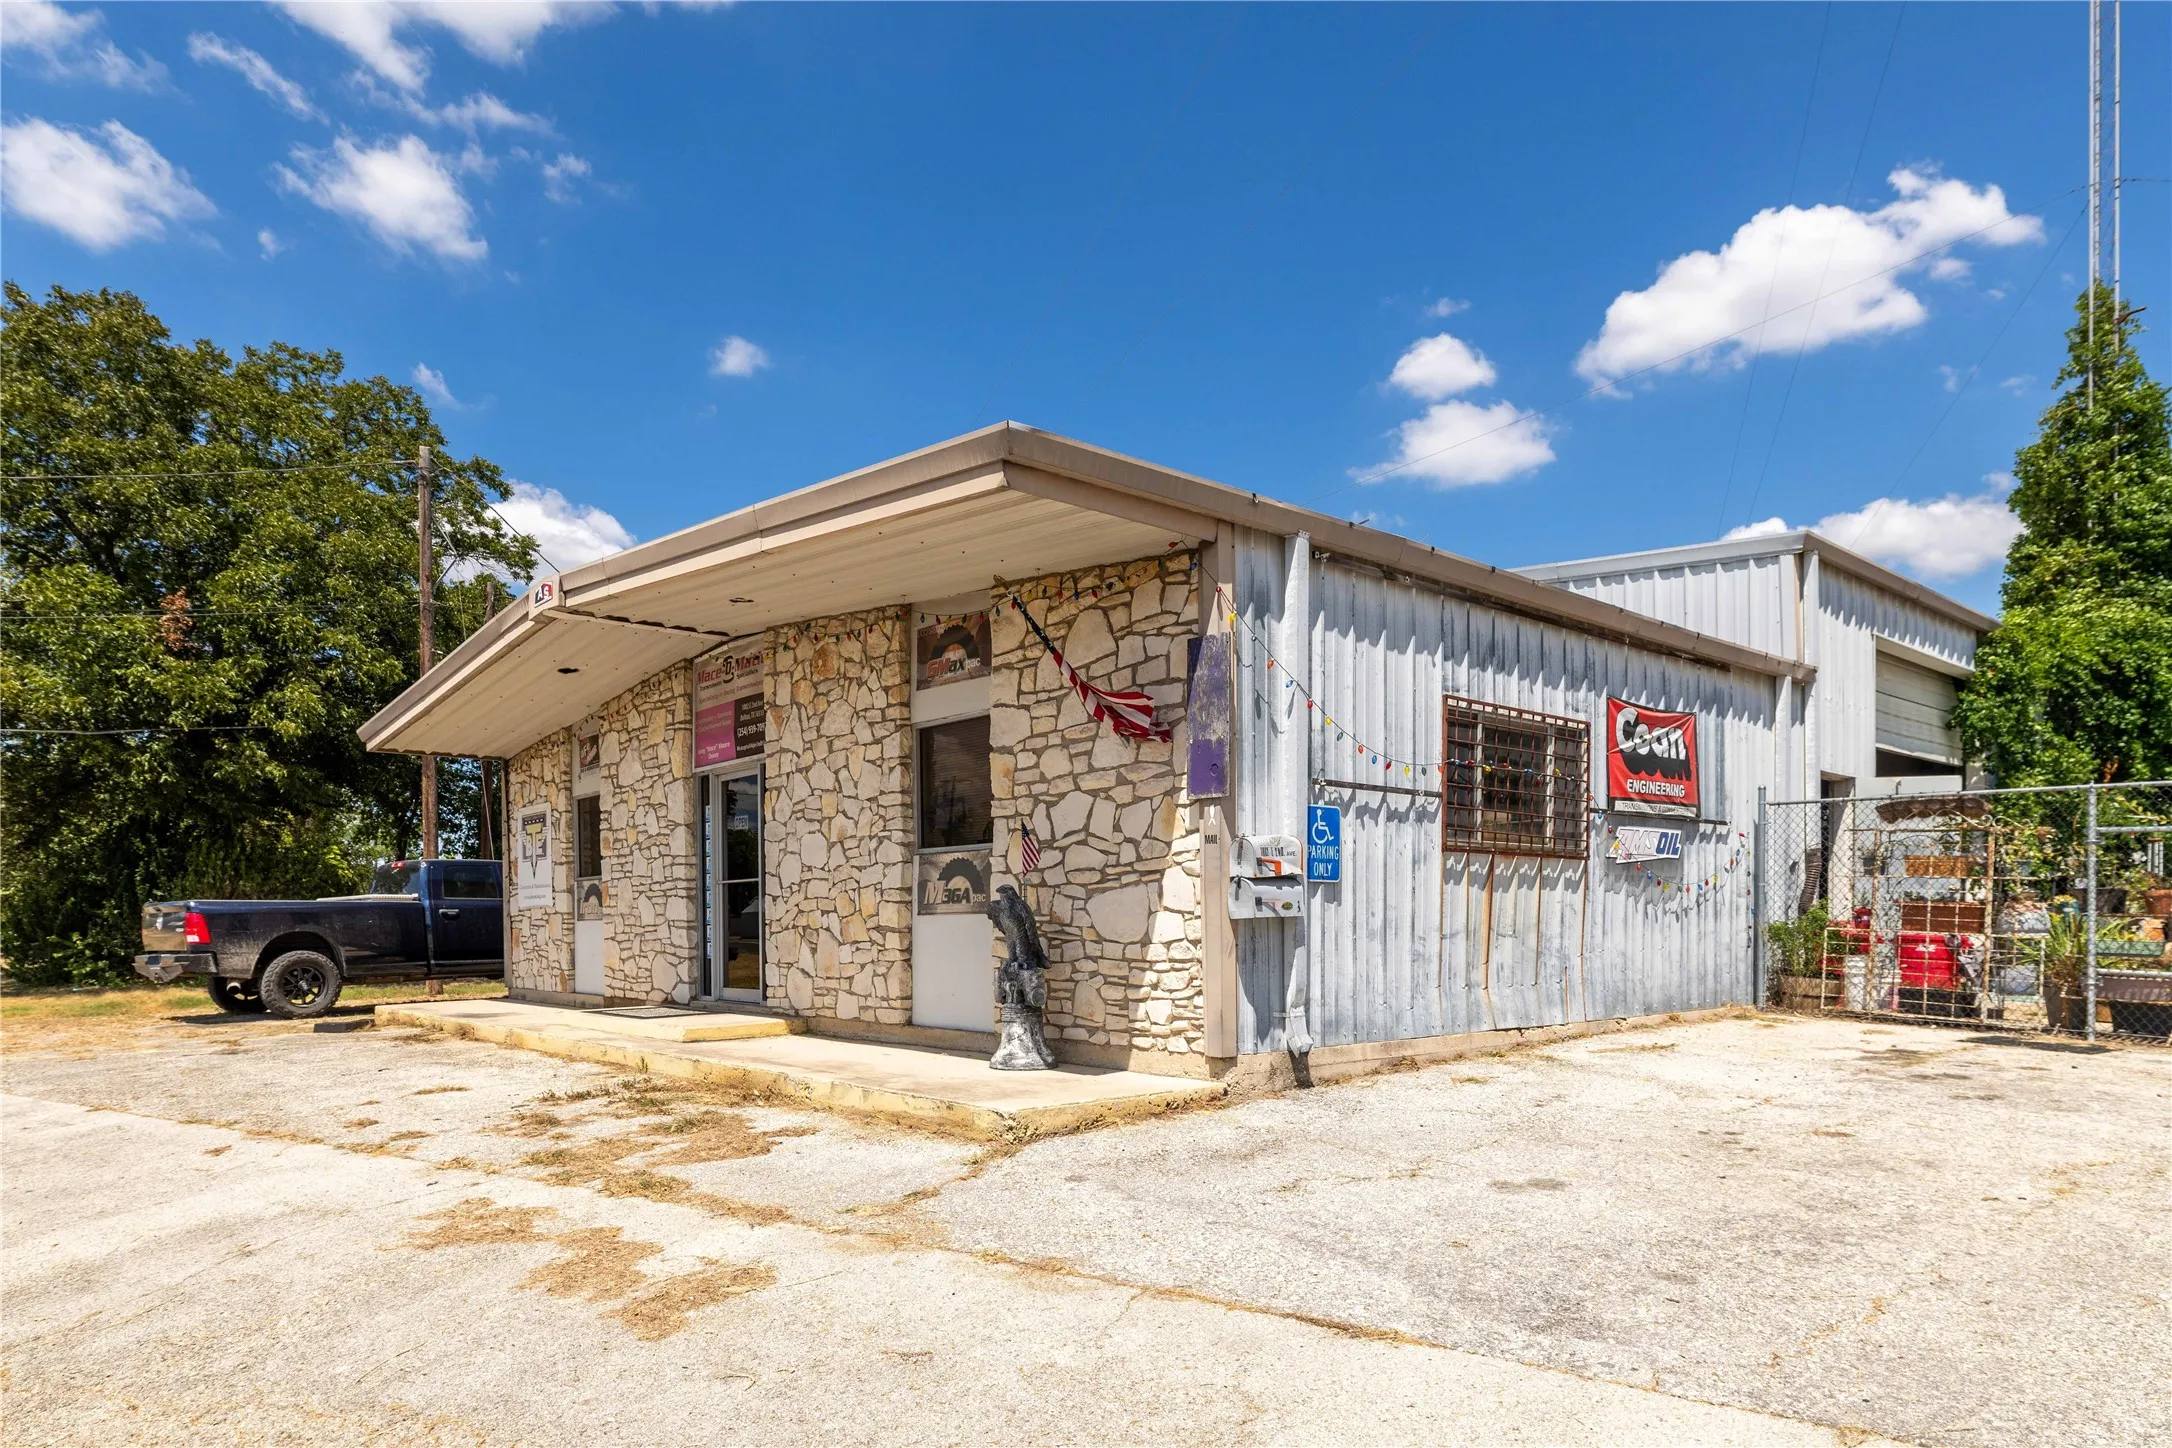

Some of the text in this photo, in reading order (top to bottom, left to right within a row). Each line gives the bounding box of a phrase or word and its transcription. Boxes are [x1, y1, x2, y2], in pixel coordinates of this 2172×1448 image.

[1615, 707, 1687, 761] Coan
[1626, 778, 1686, 798] ENGINEERING
[1204, 834, 1218, 845] MAIL
[1615, 828, 1681, 858] AMSOIL
[1308, 845, 1339, 860] PARKING
[1313, 862, 1333, 877] ONLY
